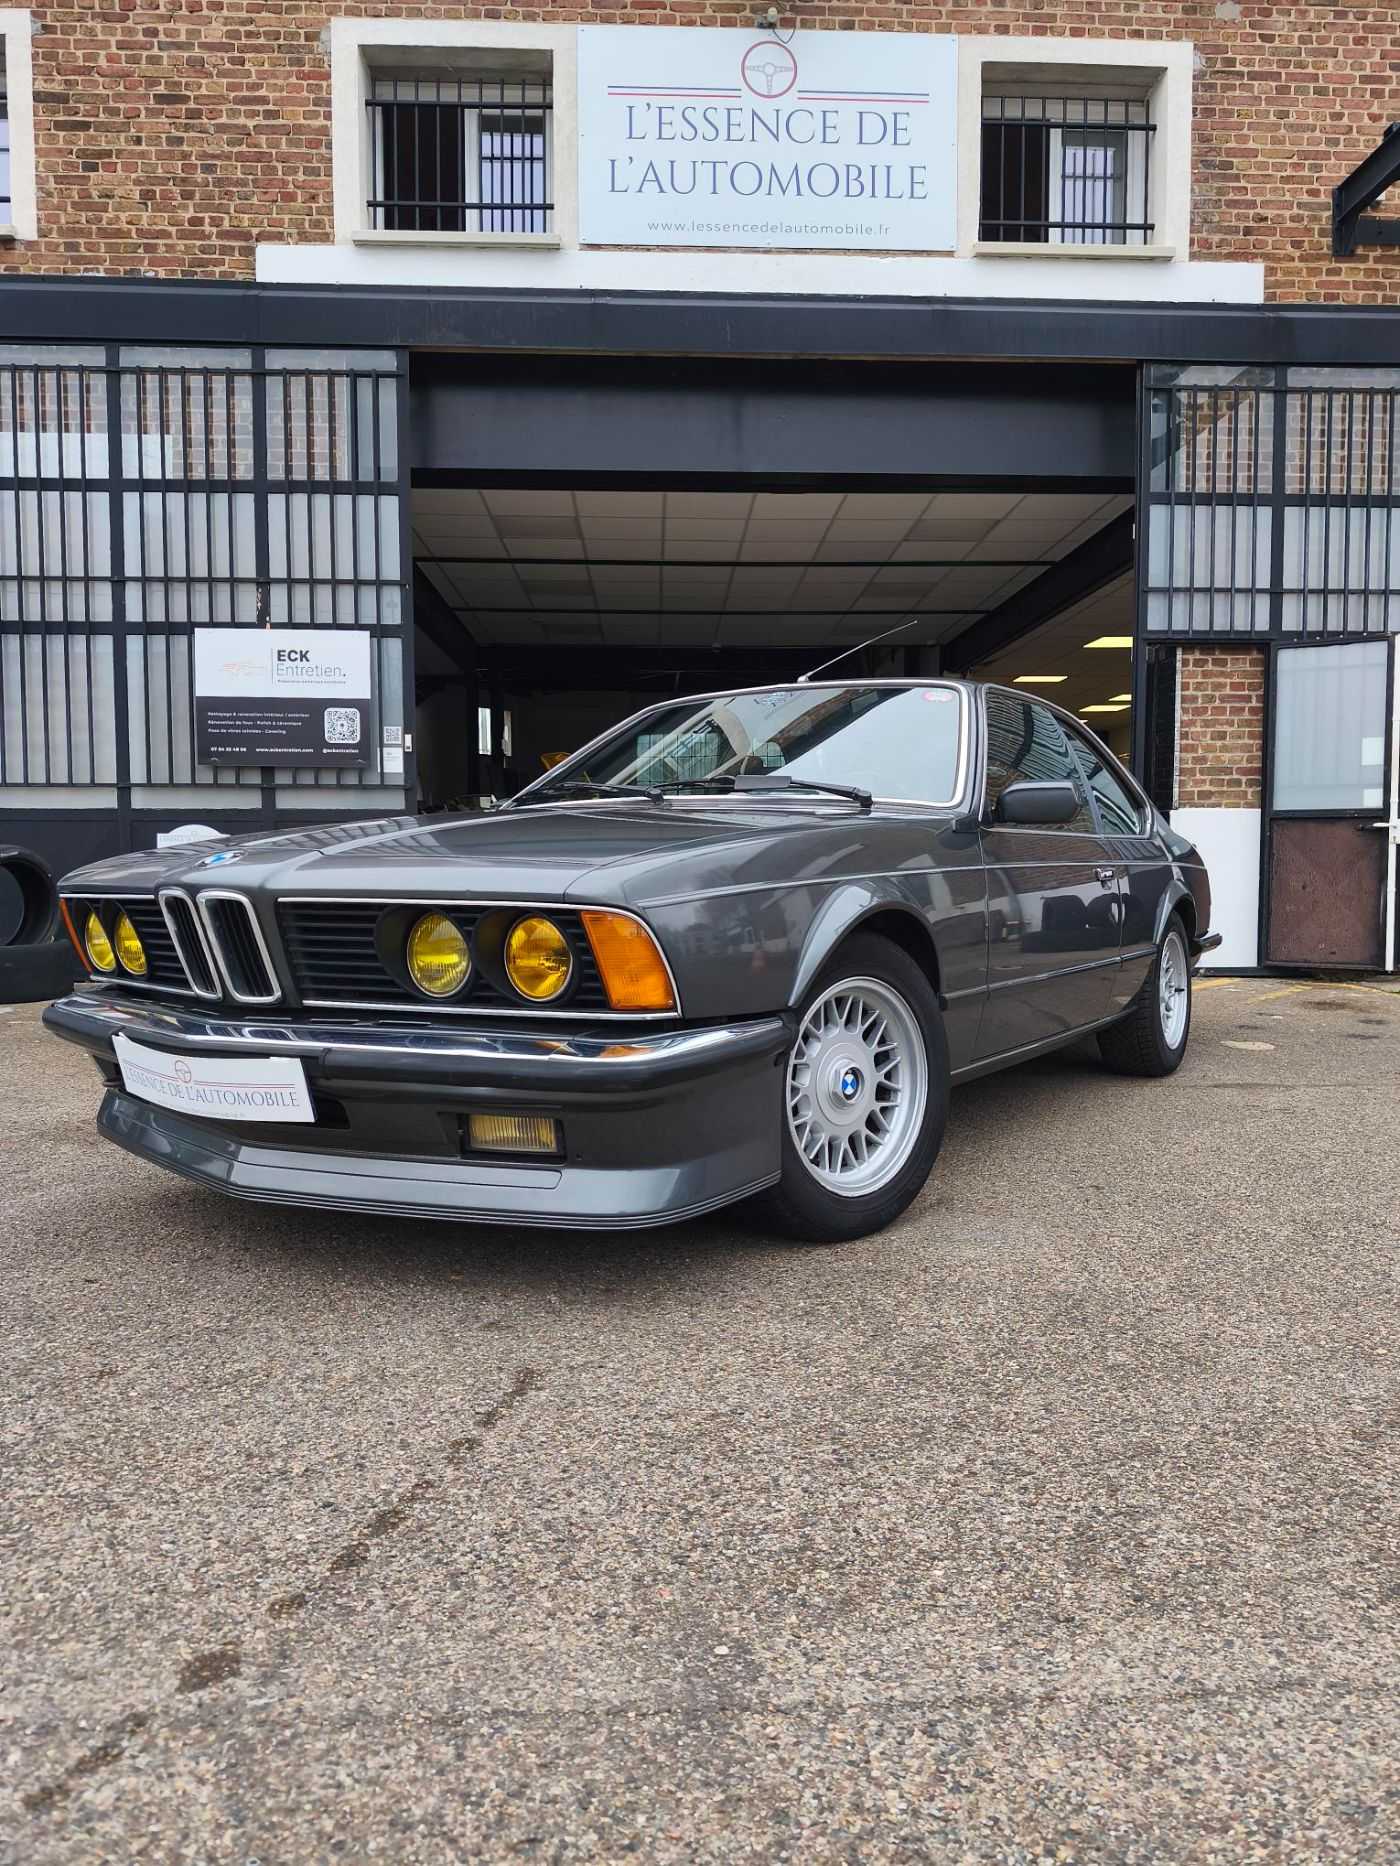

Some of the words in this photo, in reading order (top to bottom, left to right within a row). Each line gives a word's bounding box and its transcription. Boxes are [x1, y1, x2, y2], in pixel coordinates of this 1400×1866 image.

[625, 102, 841, 145] L'ESSENCE
[856, 110, 912, 147] DE
[607, 156, 929, 201] L'AUTOMOBILE
[647, 219, 890, 236] www.lessencedelautomobile.fr
[276, 649, 310, 662] ECK
[168, 1081, 185, 1099] DE
[184, 1085, 300, 1107] L'AUTOMOBILE
